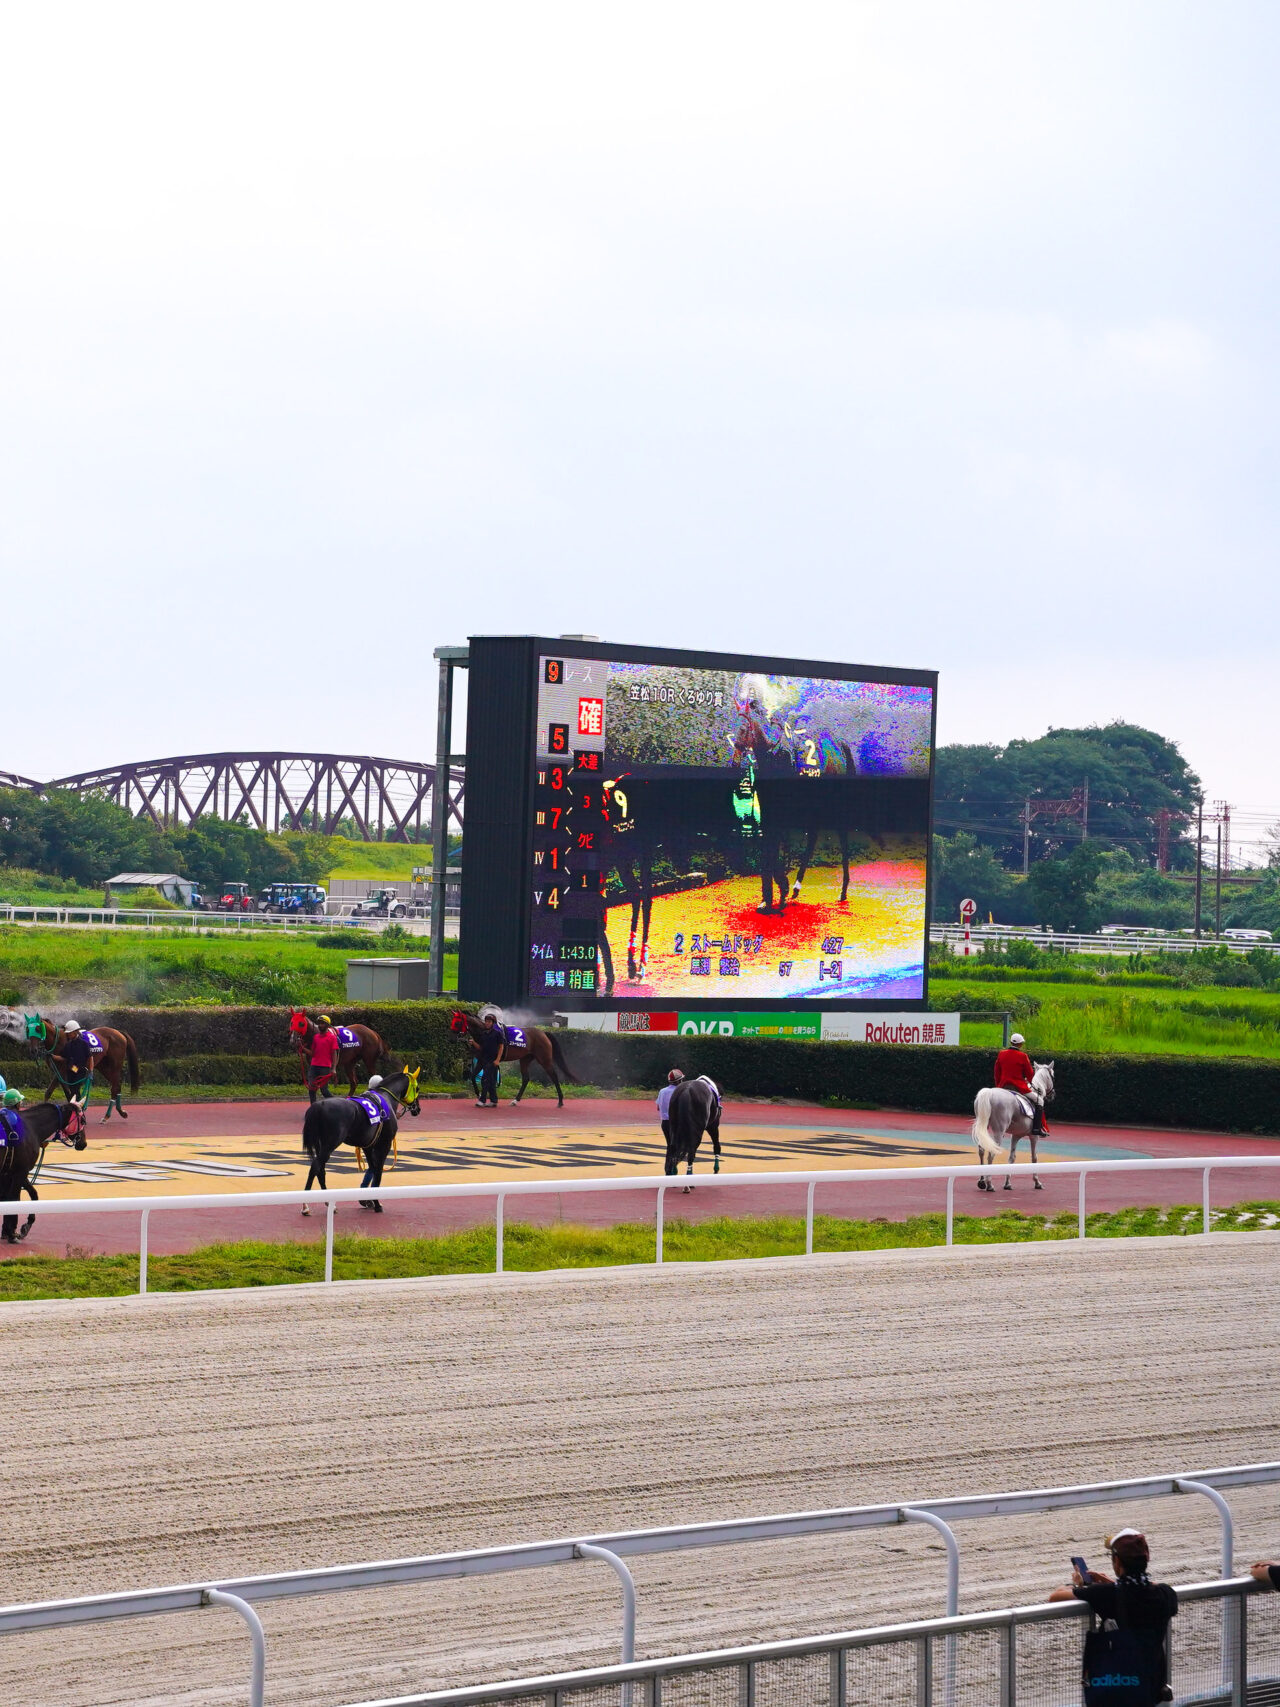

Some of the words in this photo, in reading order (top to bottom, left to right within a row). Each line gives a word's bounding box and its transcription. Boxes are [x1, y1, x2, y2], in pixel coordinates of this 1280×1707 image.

[548, 661, 559, 682] 9
[565, 664, 593, 683] レース
[579, 699, 602, 734] 確
[553, 727, 564, 750] 5
[578, 753, 598, 770] 大差
[805, 739, 817, 766] 2
[551, 767, 563, 790] 3
[583, 795, 591, 809] 3
[613, 789, 628, 818] 9
[550, 807, 562, 830] 7
[577, 832, 594, 849] クビ
[550, 847, 558, 870] 1
[581, 874, 588, 888] 1
[547, 887, 559, 909] 4
[962, 900, 974, 915] 4
[531, 943, 554, 960] タイム
[560, 945, 595, 960] 1:43.0
[674, 932, 685, 954] 2
[690, 933, 764, 953] ストームドッグ
[821, 937, 844, 954] 427
[779, 961, 792, 976] 57
[544, 970, 565, 987] 馬場
[569, 969, 595, 990] 稍重
[87, 1033, 99, 1046] 8
[343, 1030, 353, 1041] 9
[514, 1029, 524, 1042] 2
[865, 1021, 920, 1043] Rakuten
[922, 1023, 945, 1043] 競馬
[361, 1100, 377, 1116] 3
[1090, 1673, 1140, 1688] adidas
